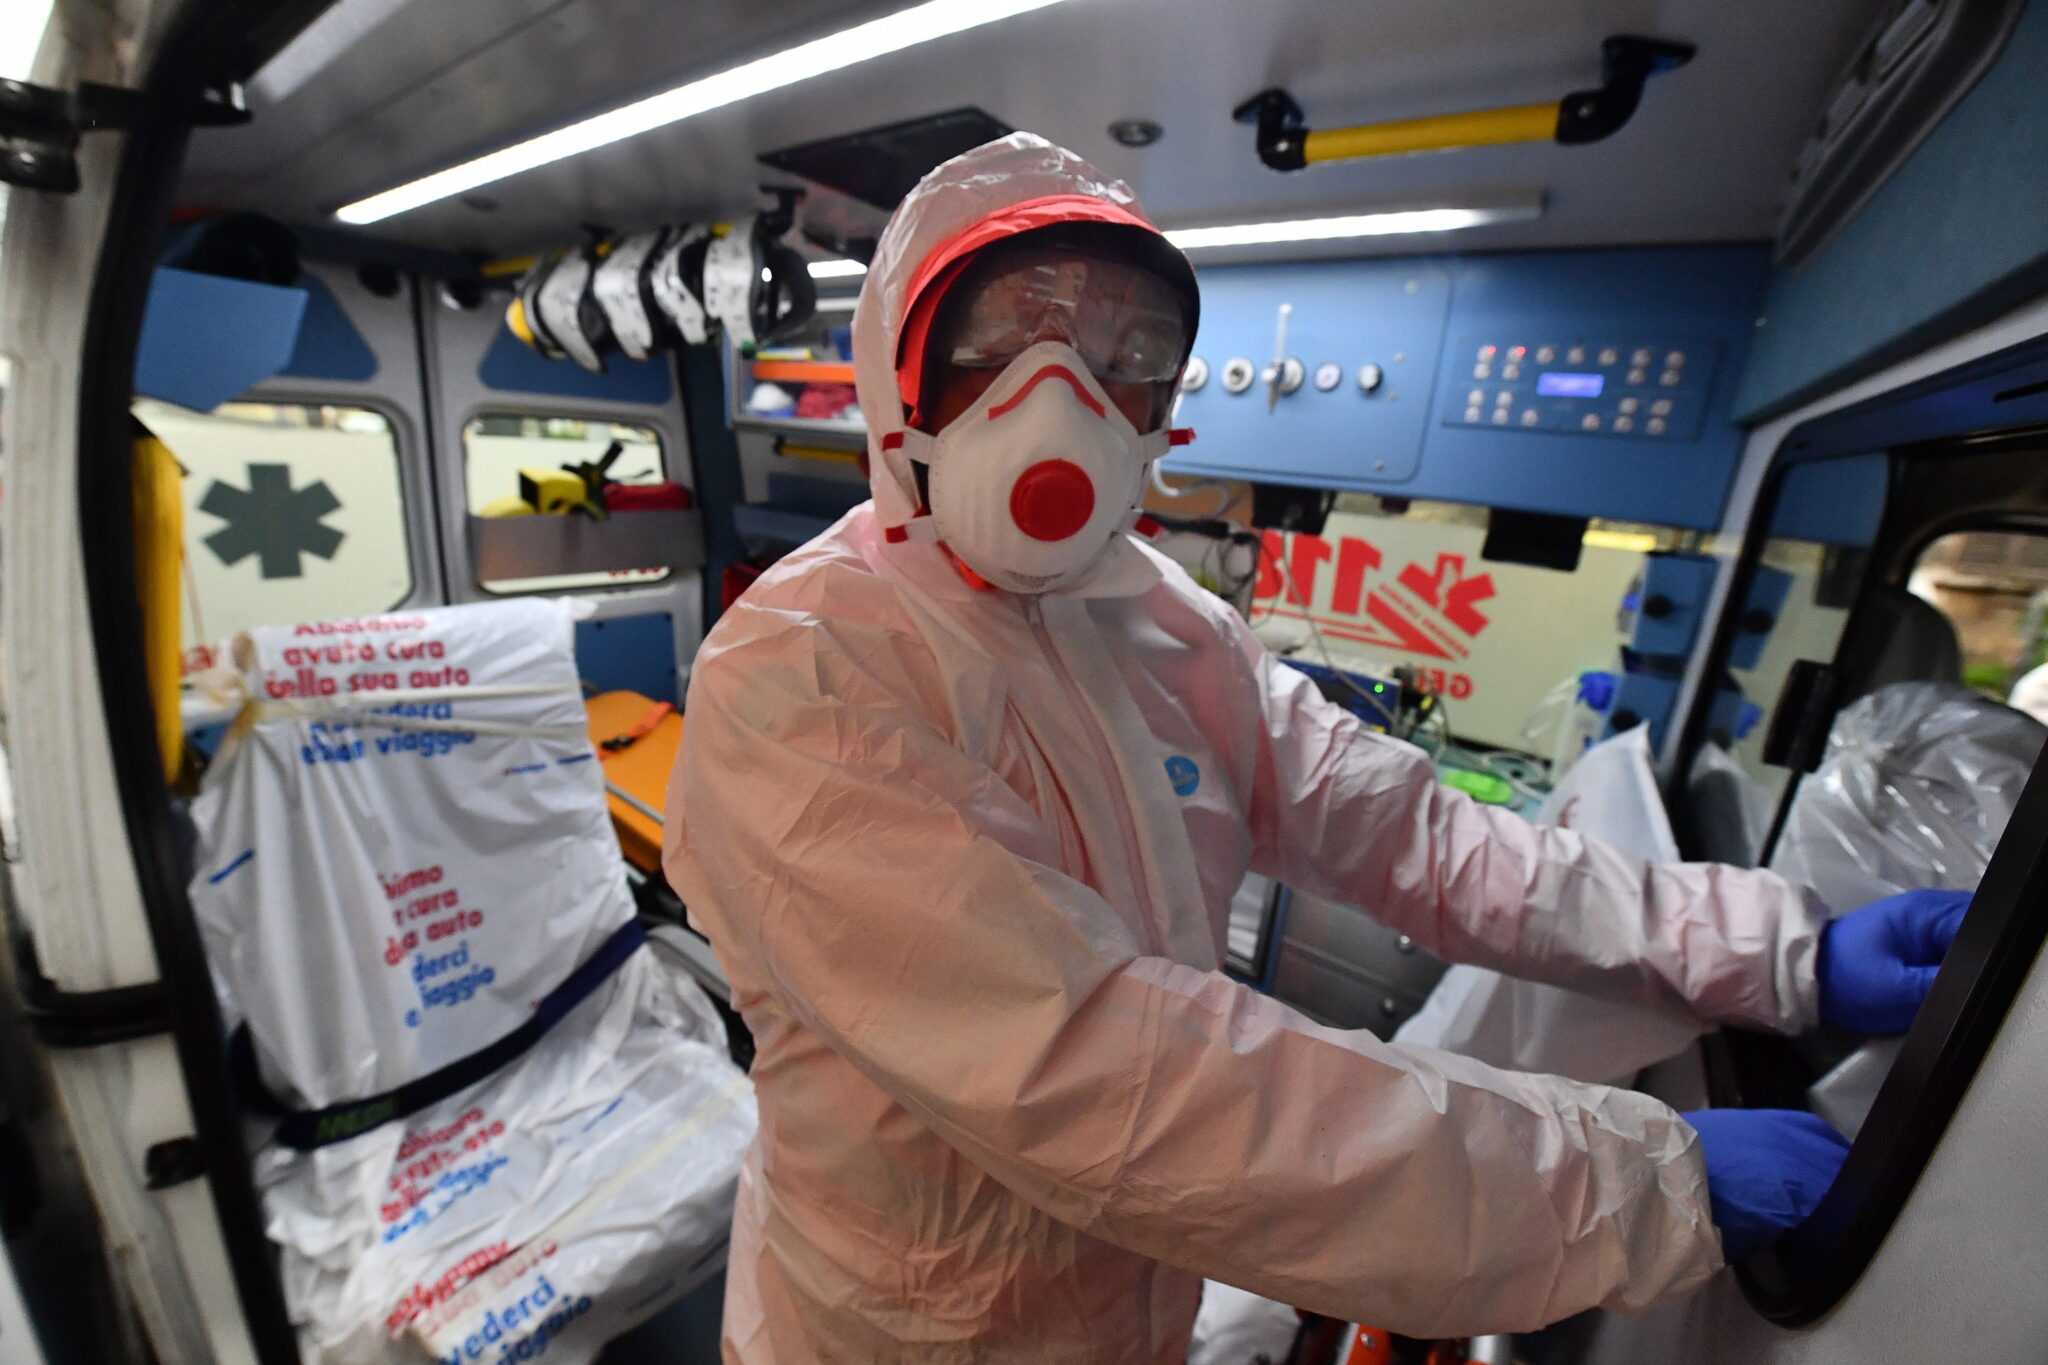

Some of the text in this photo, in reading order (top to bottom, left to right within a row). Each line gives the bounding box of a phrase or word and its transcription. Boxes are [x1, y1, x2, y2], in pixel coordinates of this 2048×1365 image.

[283, 640, 446, 667] avuto cura
[347, 672, 398, 692] sua
[409, 666, 470, 690] auto
